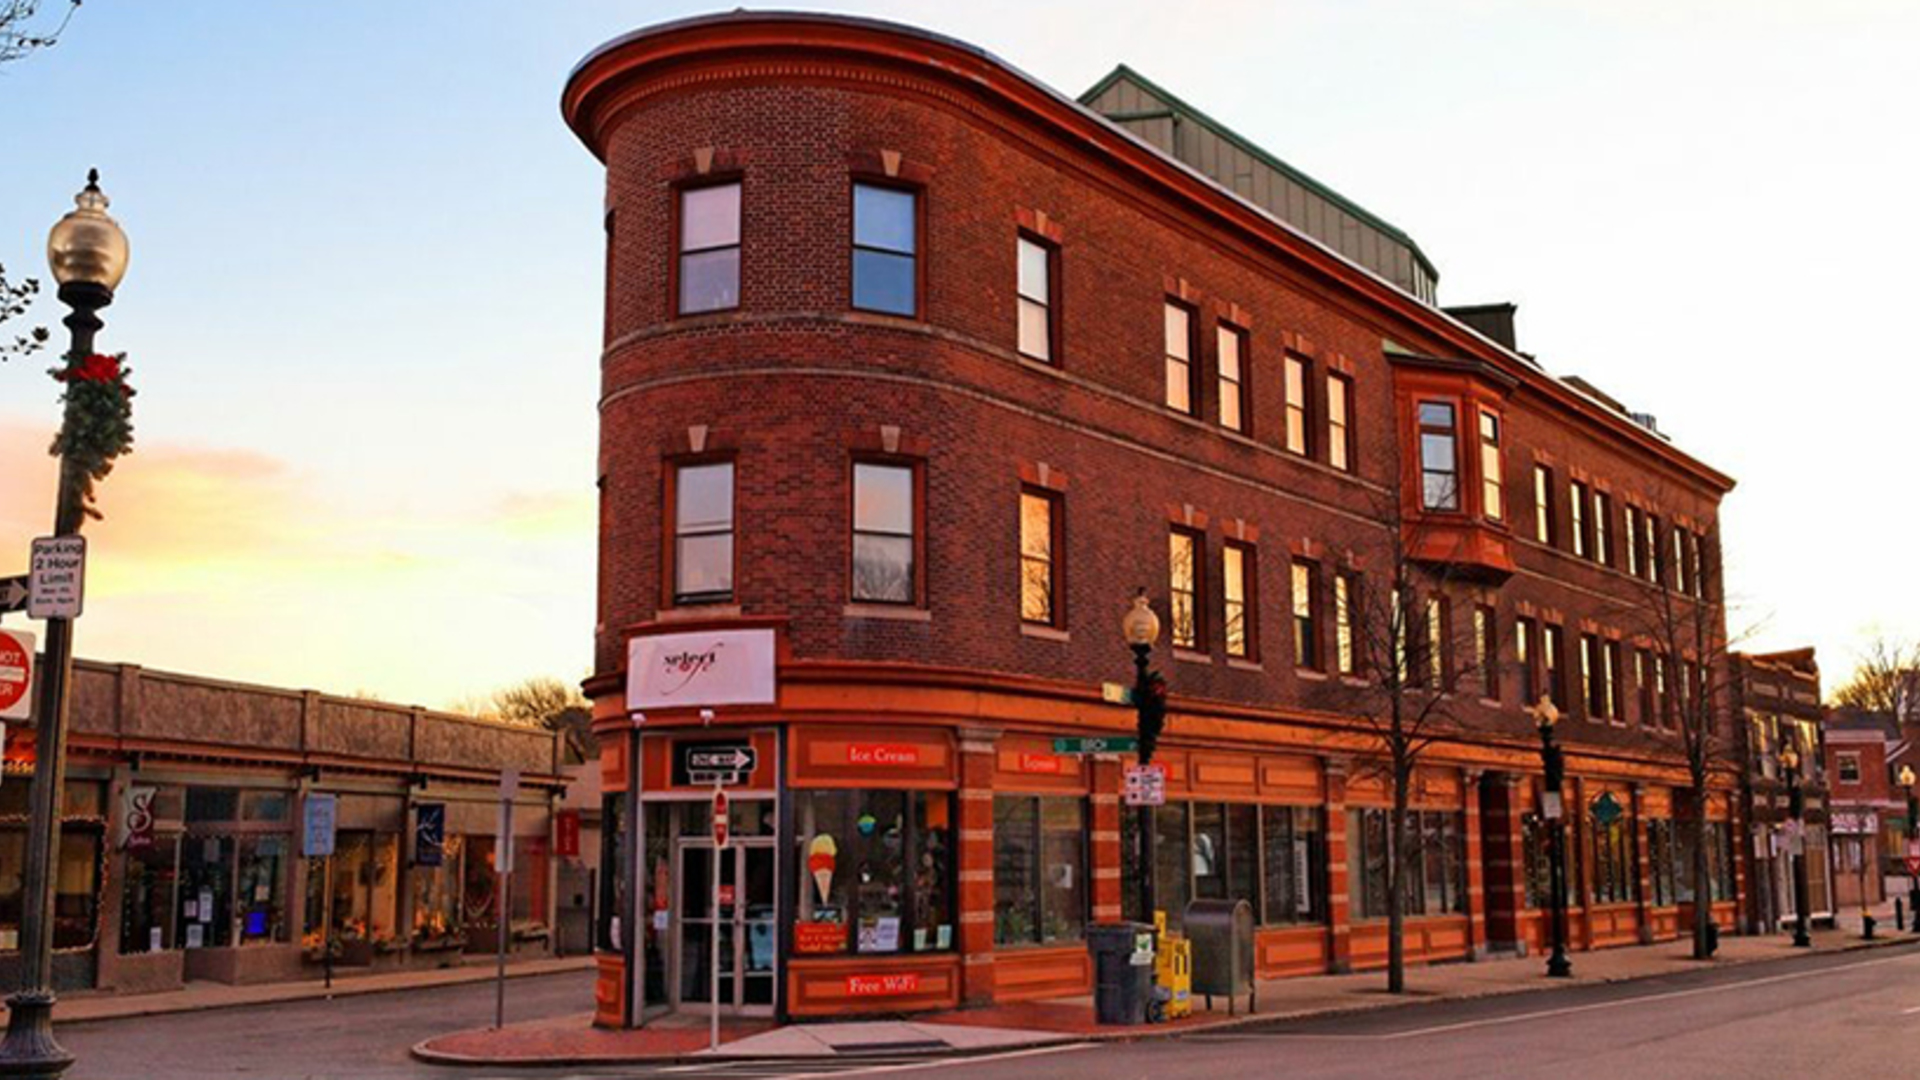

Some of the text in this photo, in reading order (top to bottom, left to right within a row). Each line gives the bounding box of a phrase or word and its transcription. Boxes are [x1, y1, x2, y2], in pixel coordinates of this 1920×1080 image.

[34, 543, 82, 555] Parking
[35, 557, 79, 571] 2 Hour
[40, 572, 74, 585] Limit
[850, 747, 917, 763] Ice Cream
[850, 976, 916, 994] Free WiFi
